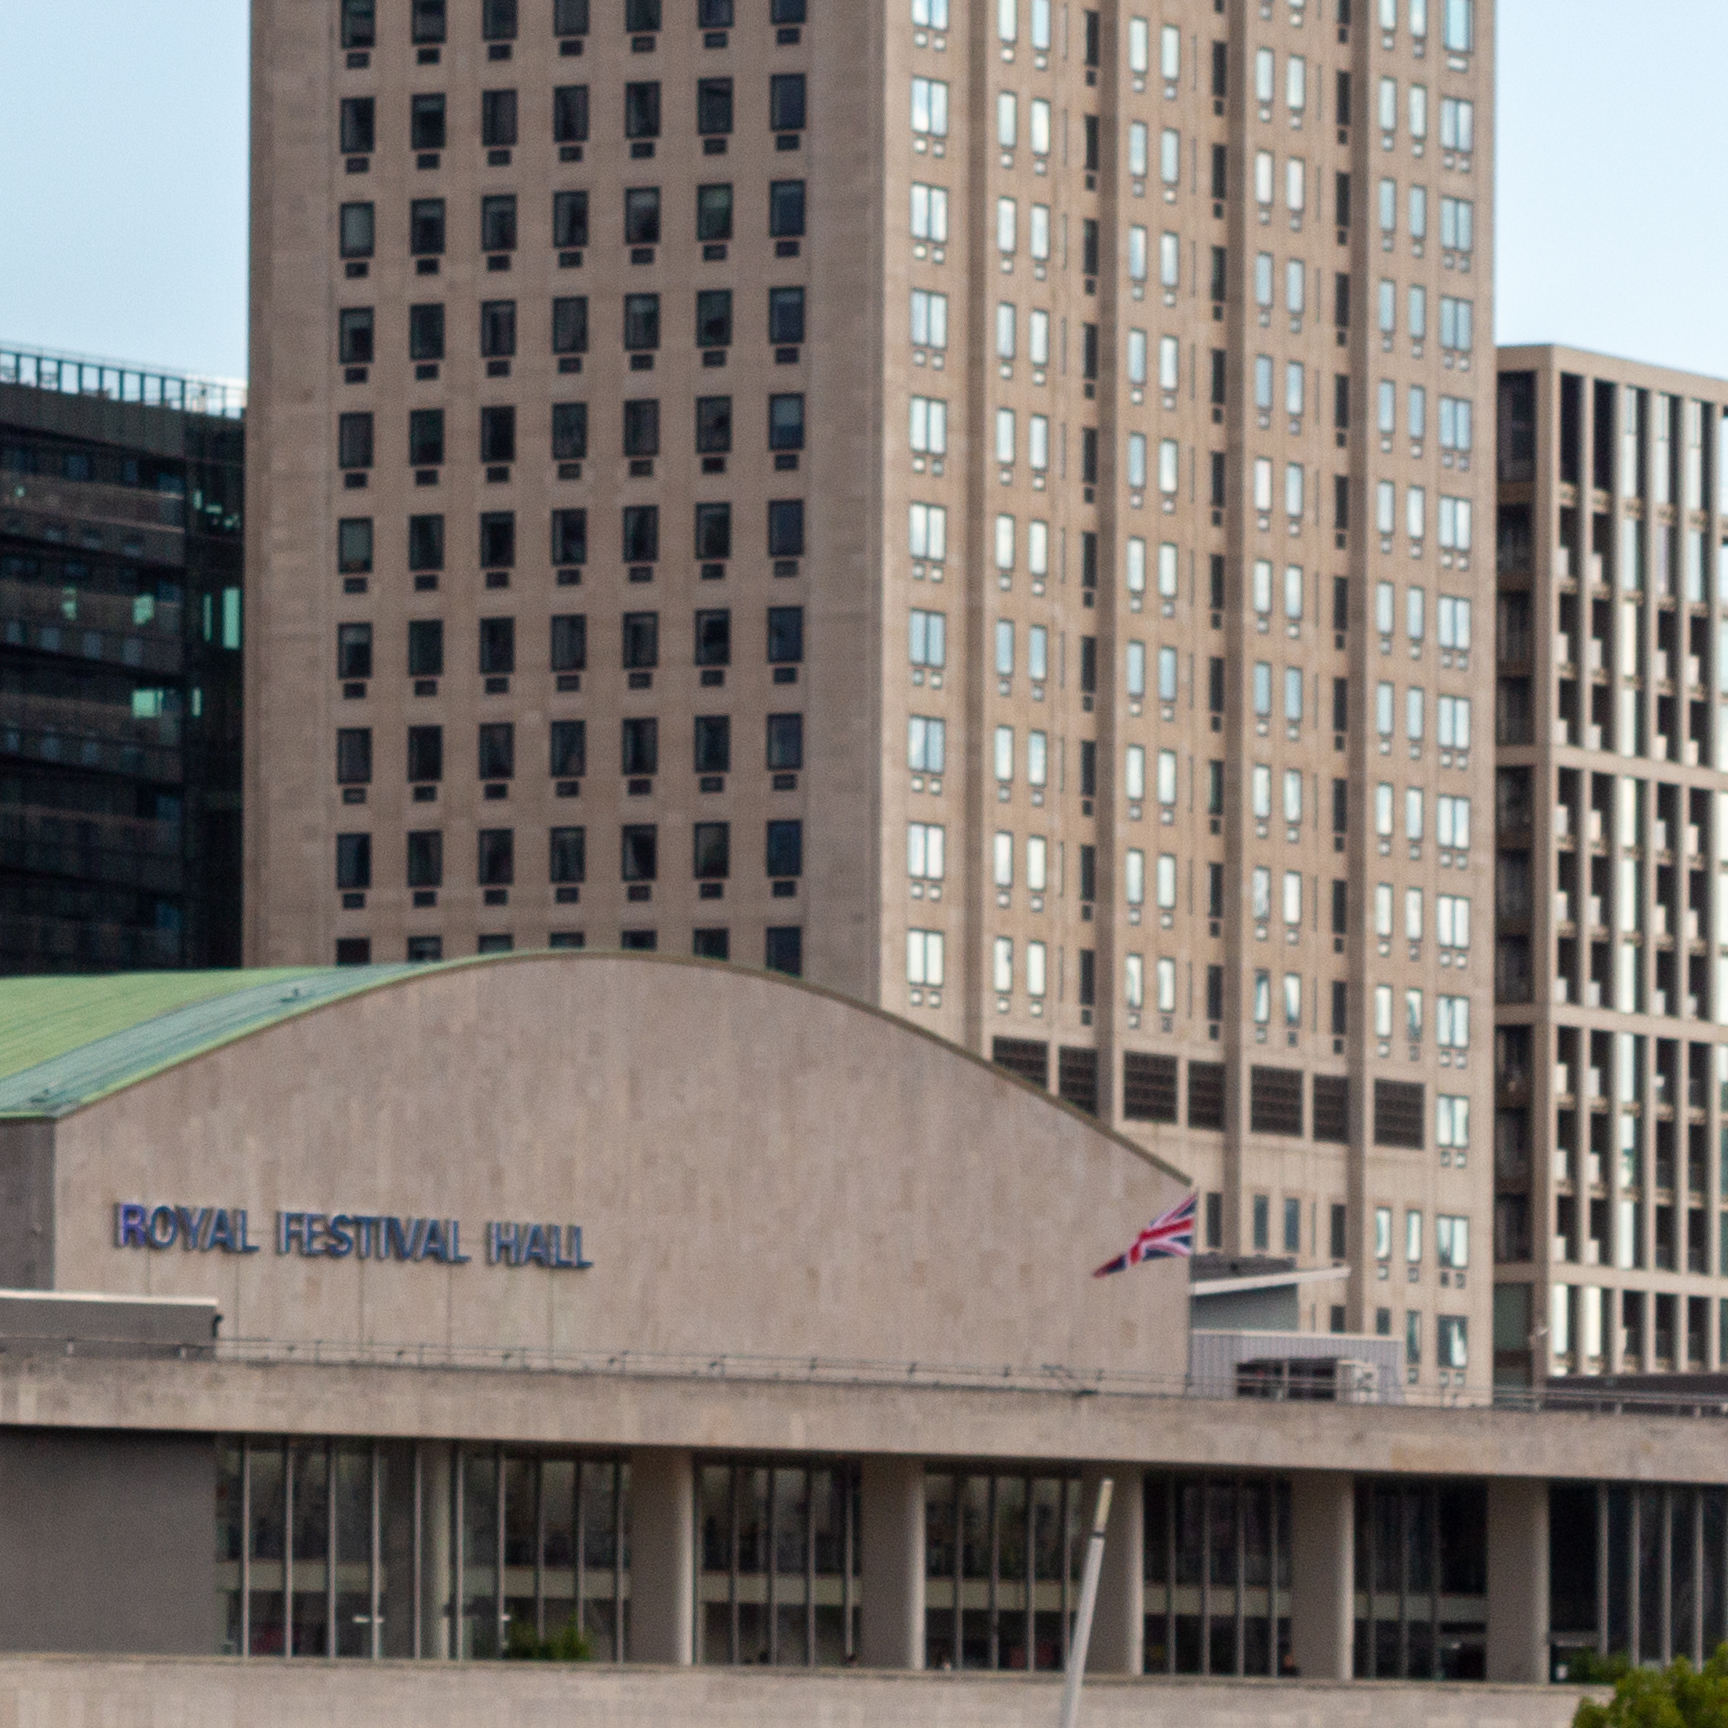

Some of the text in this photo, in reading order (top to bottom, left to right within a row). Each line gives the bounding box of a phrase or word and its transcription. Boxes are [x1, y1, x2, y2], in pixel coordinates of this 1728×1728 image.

[115, 1202, 593, 1270] ROYAL FESTIVAL HALL
